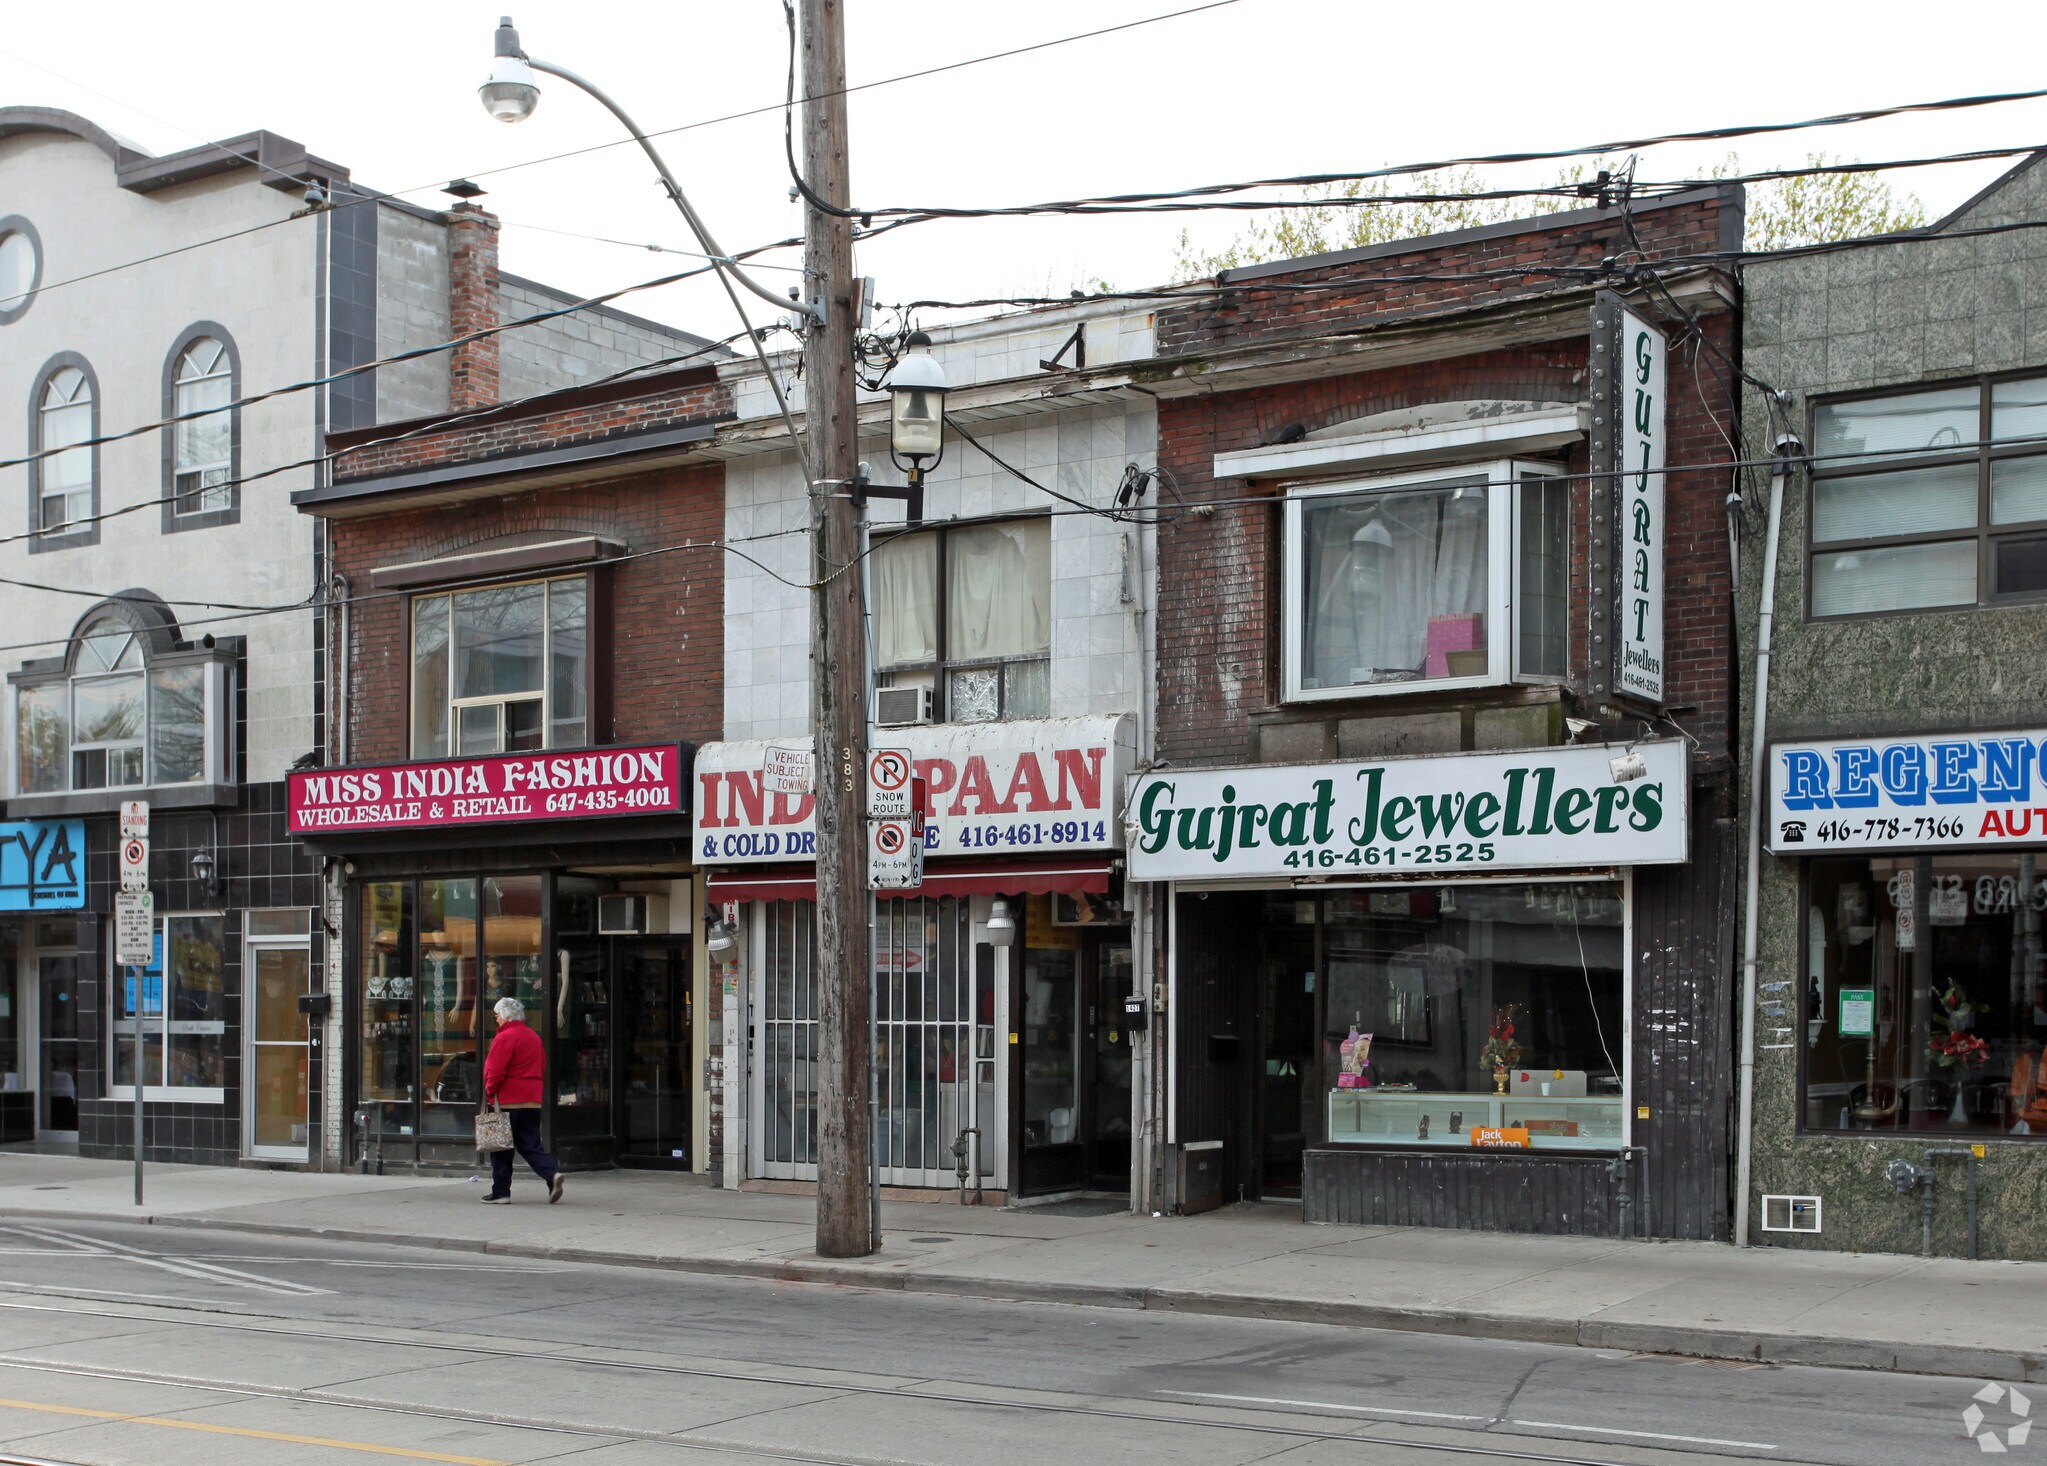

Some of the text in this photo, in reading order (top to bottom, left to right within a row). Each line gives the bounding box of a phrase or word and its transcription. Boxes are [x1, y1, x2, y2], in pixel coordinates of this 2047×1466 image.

[1633, 331, 1652, 643] GUJRAT
[1623, 640, 1660, 675] Jewellers
[1624, 672, 1659, 695] 416-461-2525
[303, 751, 665, 806] MISS INDIA FASHION
[767, 763, 805, 777] SUBJECT
[842, 747, 853, 792] 383
[912, 747, 1106, 817] PAAN
[1781, 737, 2047, 811] REGEN
[777, 777, 808, 790] TOWING
[876, 792, 904, 801] SNOW
[131, 804, 139, 813] NO
[297, 795, 532, 827] WHOLESALE & RETAIL
[546, 787, 671, 813] 647-435-4001
[873, 804, 905, 813] ROUTE
[122, 815, 147, 826] STANDING
[1139, 767, 1663, 863] Gujrat Jewellers
[959, 820, 1106, 848] 416-461-8914
[1816, 815, 1964, 843] 416-778-7366
[702, 834, 718, 857] &
[723, 832, 780, 857] COLD
[1283, 843, 1495, 869] 416-461-2525
[1480, 1128, 1502, 1141] Jack
